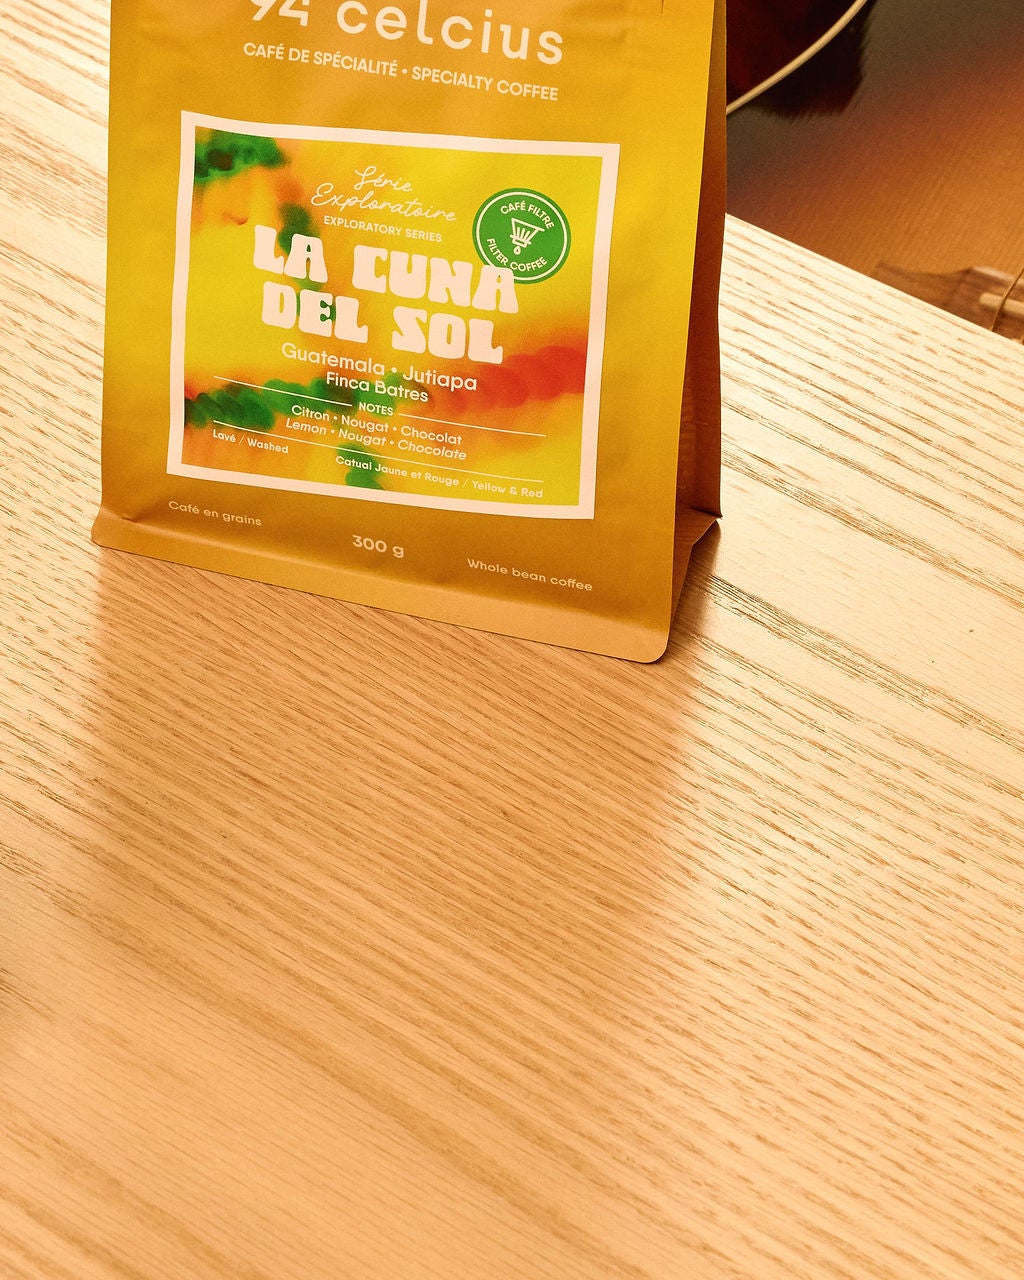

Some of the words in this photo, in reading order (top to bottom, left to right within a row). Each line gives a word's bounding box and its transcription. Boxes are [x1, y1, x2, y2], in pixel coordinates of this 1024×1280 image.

[243, 41, 285, 61] CAFÉ
[288, 48, 310, 64] DE
[313, 48, 398, 77] SPÉCIALITÉ
[411, 66, 493, 91] SPECIALTY
[496, 79, 559, 102] COFFEE
[354, 165, 413, 192] Série
[311, 182, 457, 221] Exploratoire
[500, 200, 527, 215] CAFÉ
[527, 203, 555, 230] FILTRE
[324, 215, 402, 237] EXPLORATORY
[405, 228, 442, 243] SERIES
[254, 224, 328, 284] LA
[352, 245, 519, 314] CUNA
[486, 238, 509, 266] FILTER
[509, 256, 548, 272] COFFEE
[261, 281, 369, 345] DEL
[392, 306, 504, 365] SOL
[281, 342, 386, 376] Guatemala
[402, 366, 477, 392] Jutiapa
[326, 371, 370, 392] Finca
[374, 380, 429, 403] Batres
[358, 401, 394, 416] NOTES
[212, 428, 236, 443] Lavé
[247, 437, 289, 455] Washed
[285, 418, 327, 436] Lemon
[338, 428, 387, 448] Nougat
[397, 439, 467, 461] Chocolate
[291, 405, 330, 422] Citron
[341, 415, 389, 434] Nougat
[401, 425, 462, 446] Chocolat
[374, 463, 408, 478] Jaune
[410, 470, 422, 480] et
[424, 472, 460, 487] Rouge
[471, 480, 506, 495] Yellow
[509, 486, 518, 496] &
[521, 487, 544, 499] Red
[168, 500, 200, 515] Café
[203, 507, 219, 519] en
[222, 510, 263, 527] grains
[352, 534, 387, 553] 300
[392, 544, 405, 559] g
[467, 558, 508, 574] Whole
[511, 567, 546, 583] bean
[550, 577, 593, 591] coffee
